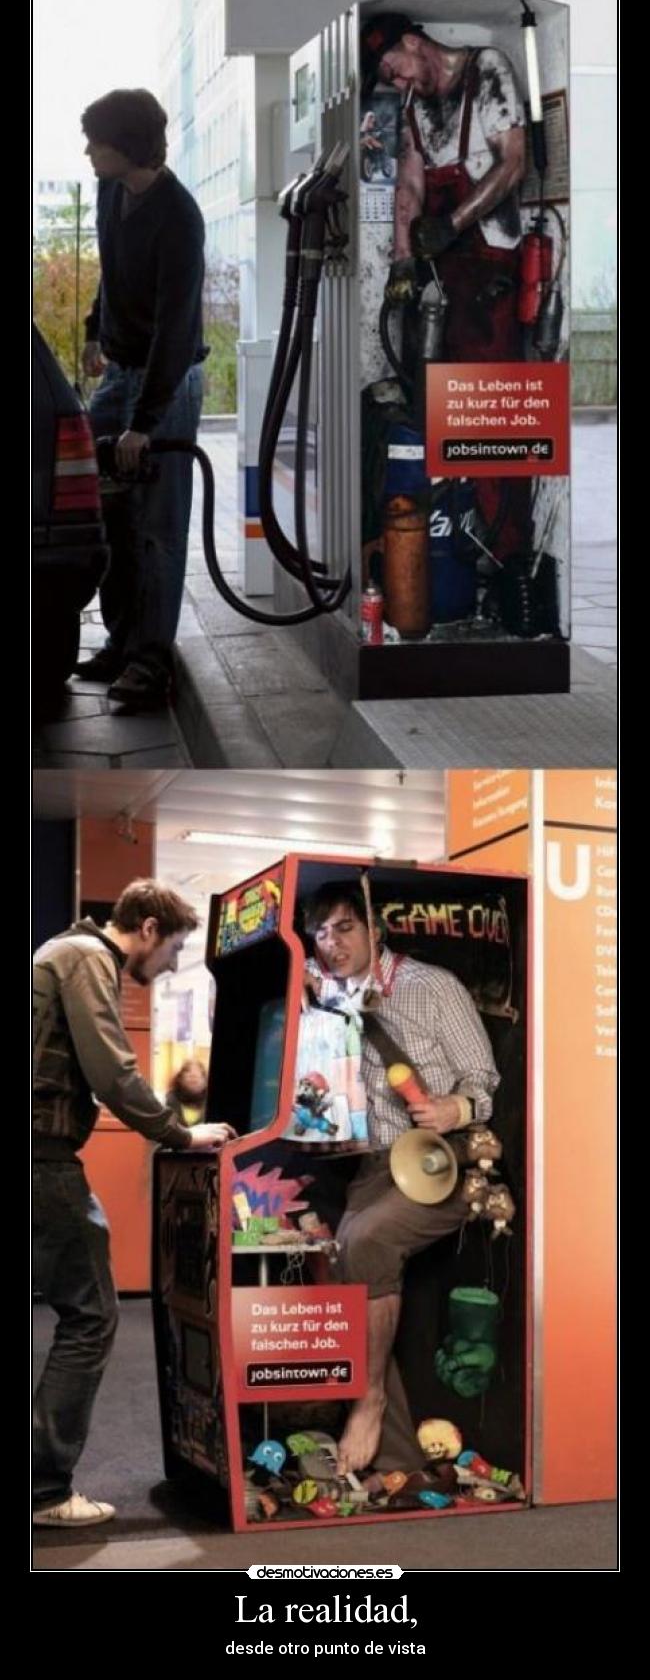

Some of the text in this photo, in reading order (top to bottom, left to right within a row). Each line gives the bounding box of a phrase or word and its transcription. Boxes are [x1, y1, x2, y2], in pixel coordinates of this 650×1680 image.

[447, 380, 542, 392] Das Leben ist
[447, 396, 549, 409] zu kurz für den
[447, 414, 540, 426] falschen Job.
[547, 841, 590, 900] U
[382, 903, 463, 937] GAME
[252, 1302, 342, 1315] Das Leben ist
[251, 1320, 348, 1333] zu kurz für den
[251, 1337, 340, 1350] falschen Job.
